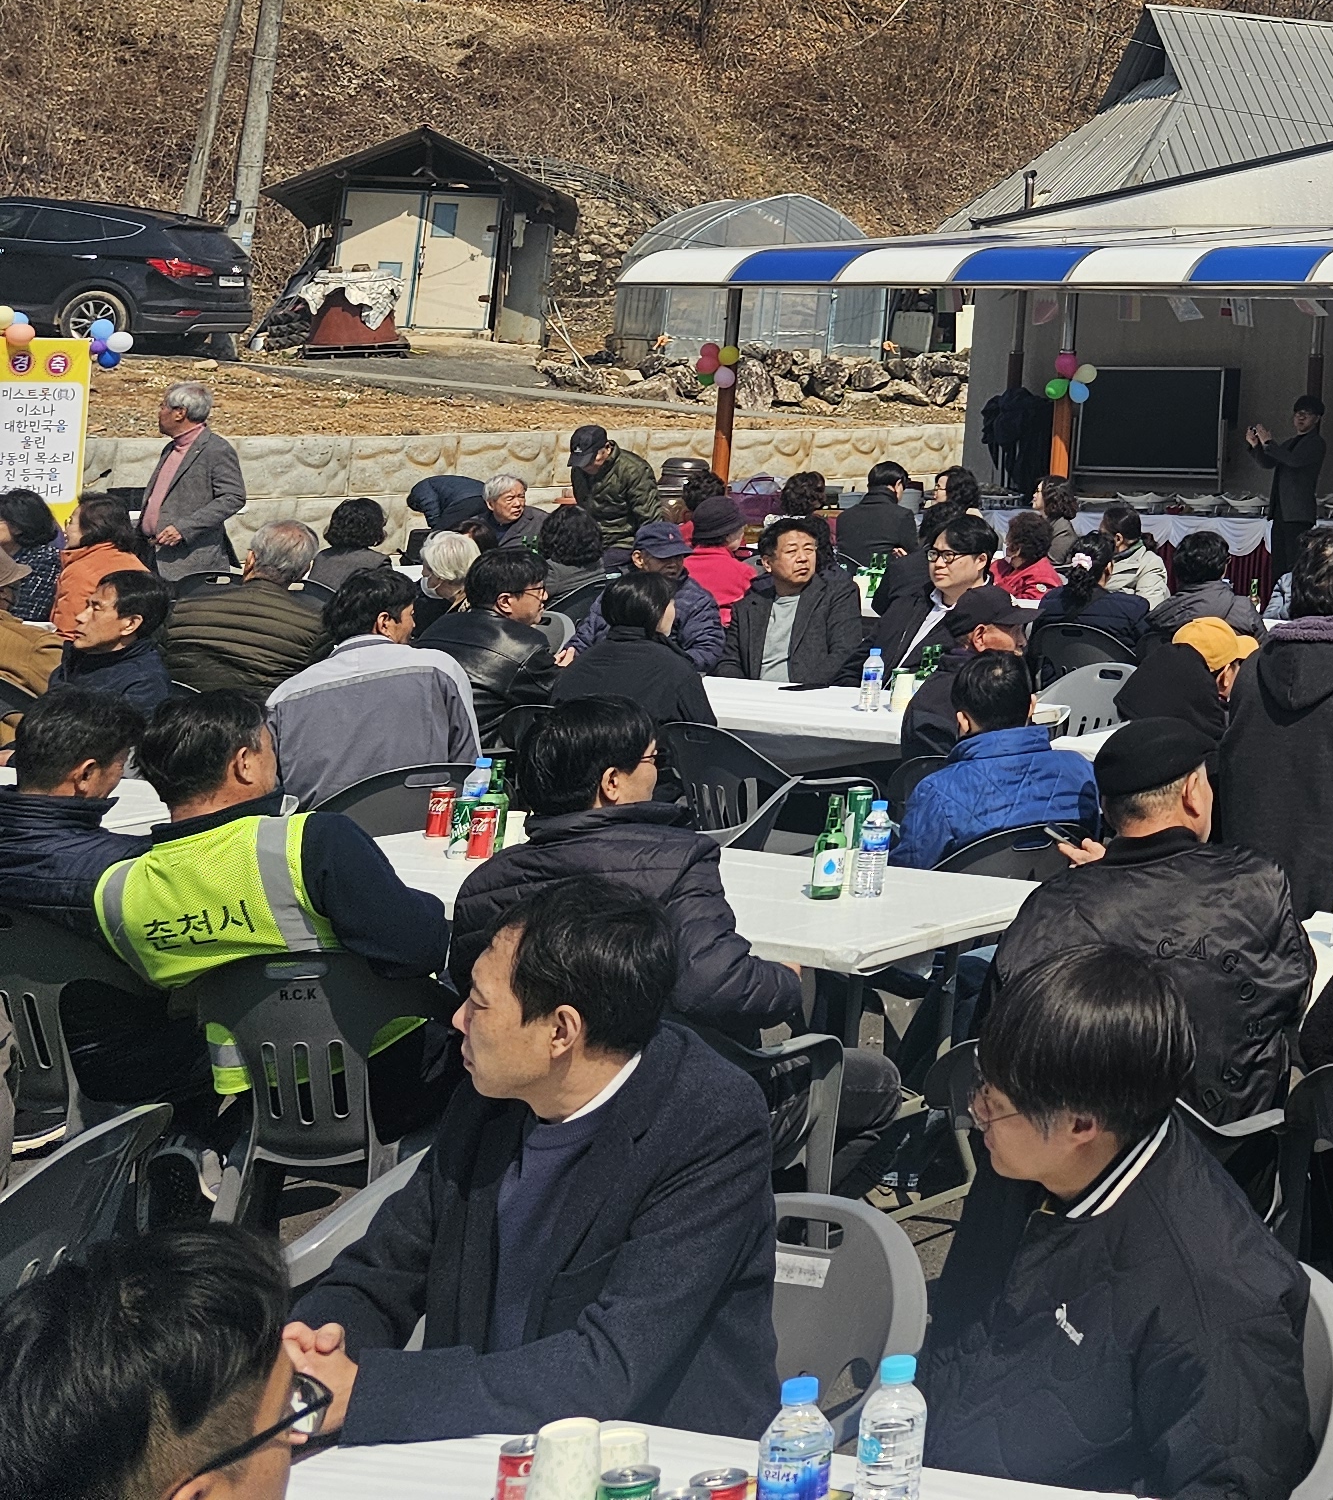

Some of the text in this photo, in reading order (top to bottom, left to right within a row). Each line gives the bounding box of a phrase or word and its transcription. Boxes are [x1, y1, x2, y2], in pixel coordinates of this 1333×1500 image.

[14, 355, 66, 373] 경 축
[17, 404, 56, 417] 이소나
[4, 419, 69, 433] 대한민국을
[21, 436, 46, 449] 울린
[35, 451, 74, 465] 목소리
[5, 467, 60, 482] 진 등극을
[144, 899, 255, 951] 춘천시
[279, 987, 317, 1001] R.C.K
